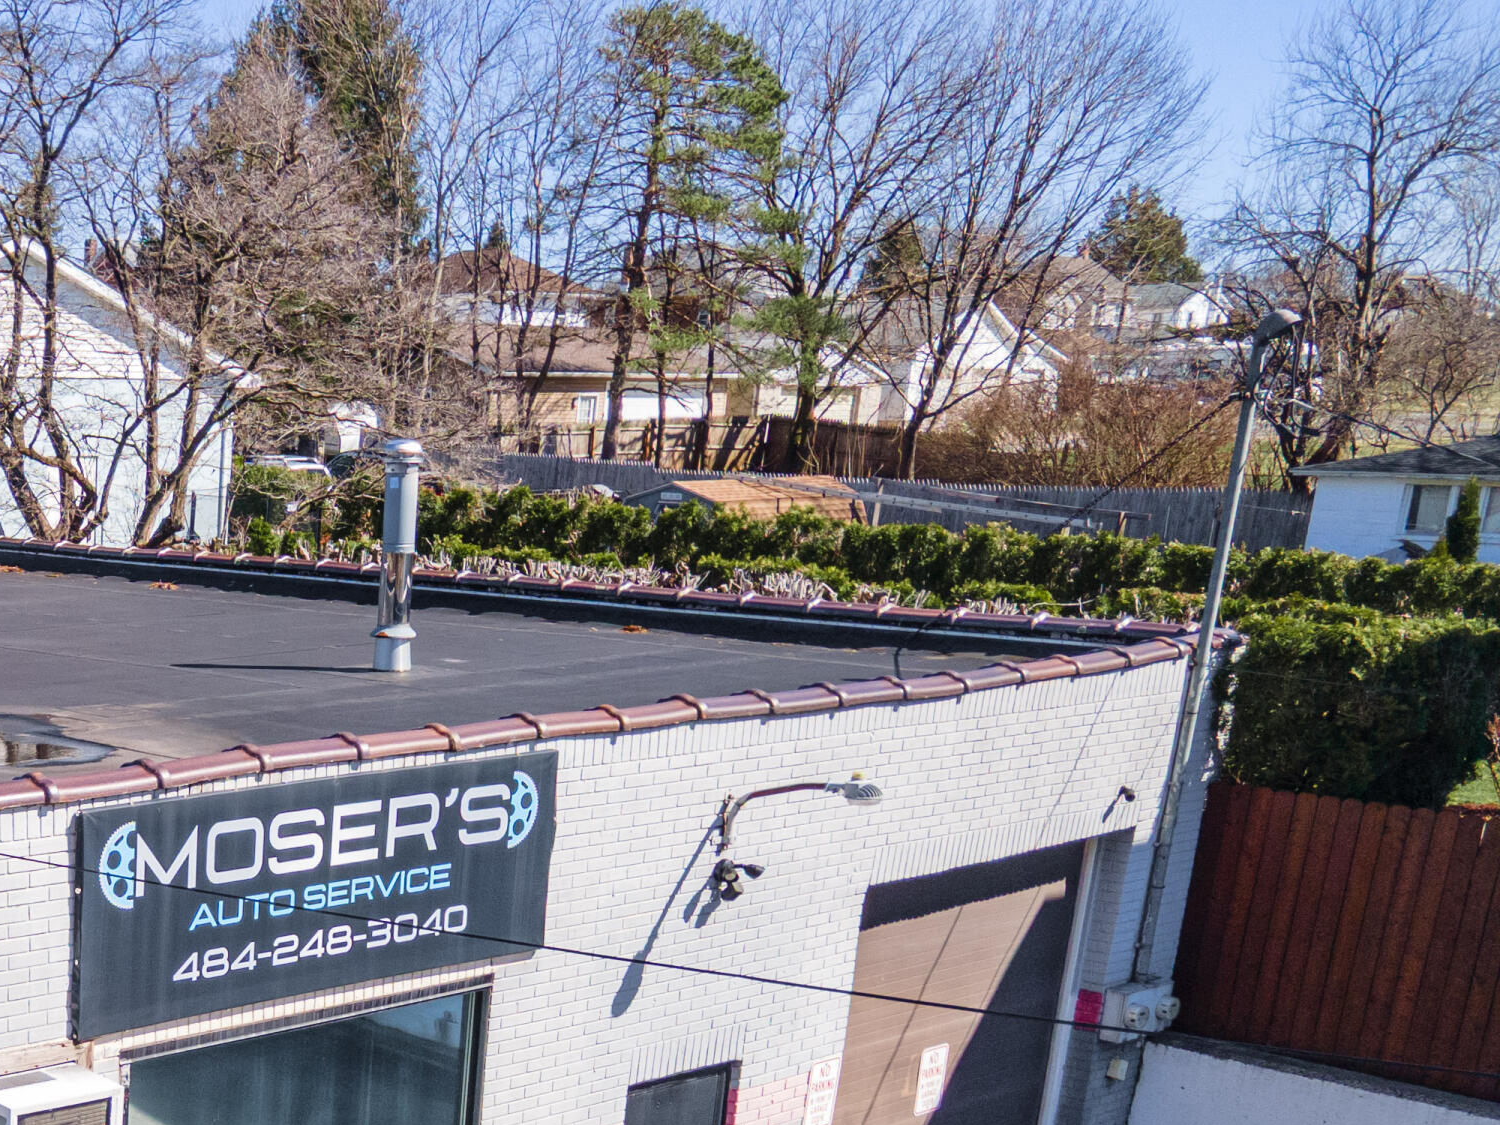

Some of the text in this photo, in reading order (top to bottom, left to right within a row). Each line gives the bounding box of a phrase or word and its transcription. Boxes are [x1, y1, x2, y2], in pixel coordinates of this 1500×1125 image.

[135, 784, 510, 898] MOSER'S
[188, 863, 452, 931] AUTO SERVICE
[172, 904, 468, 983] 484-248-3040
